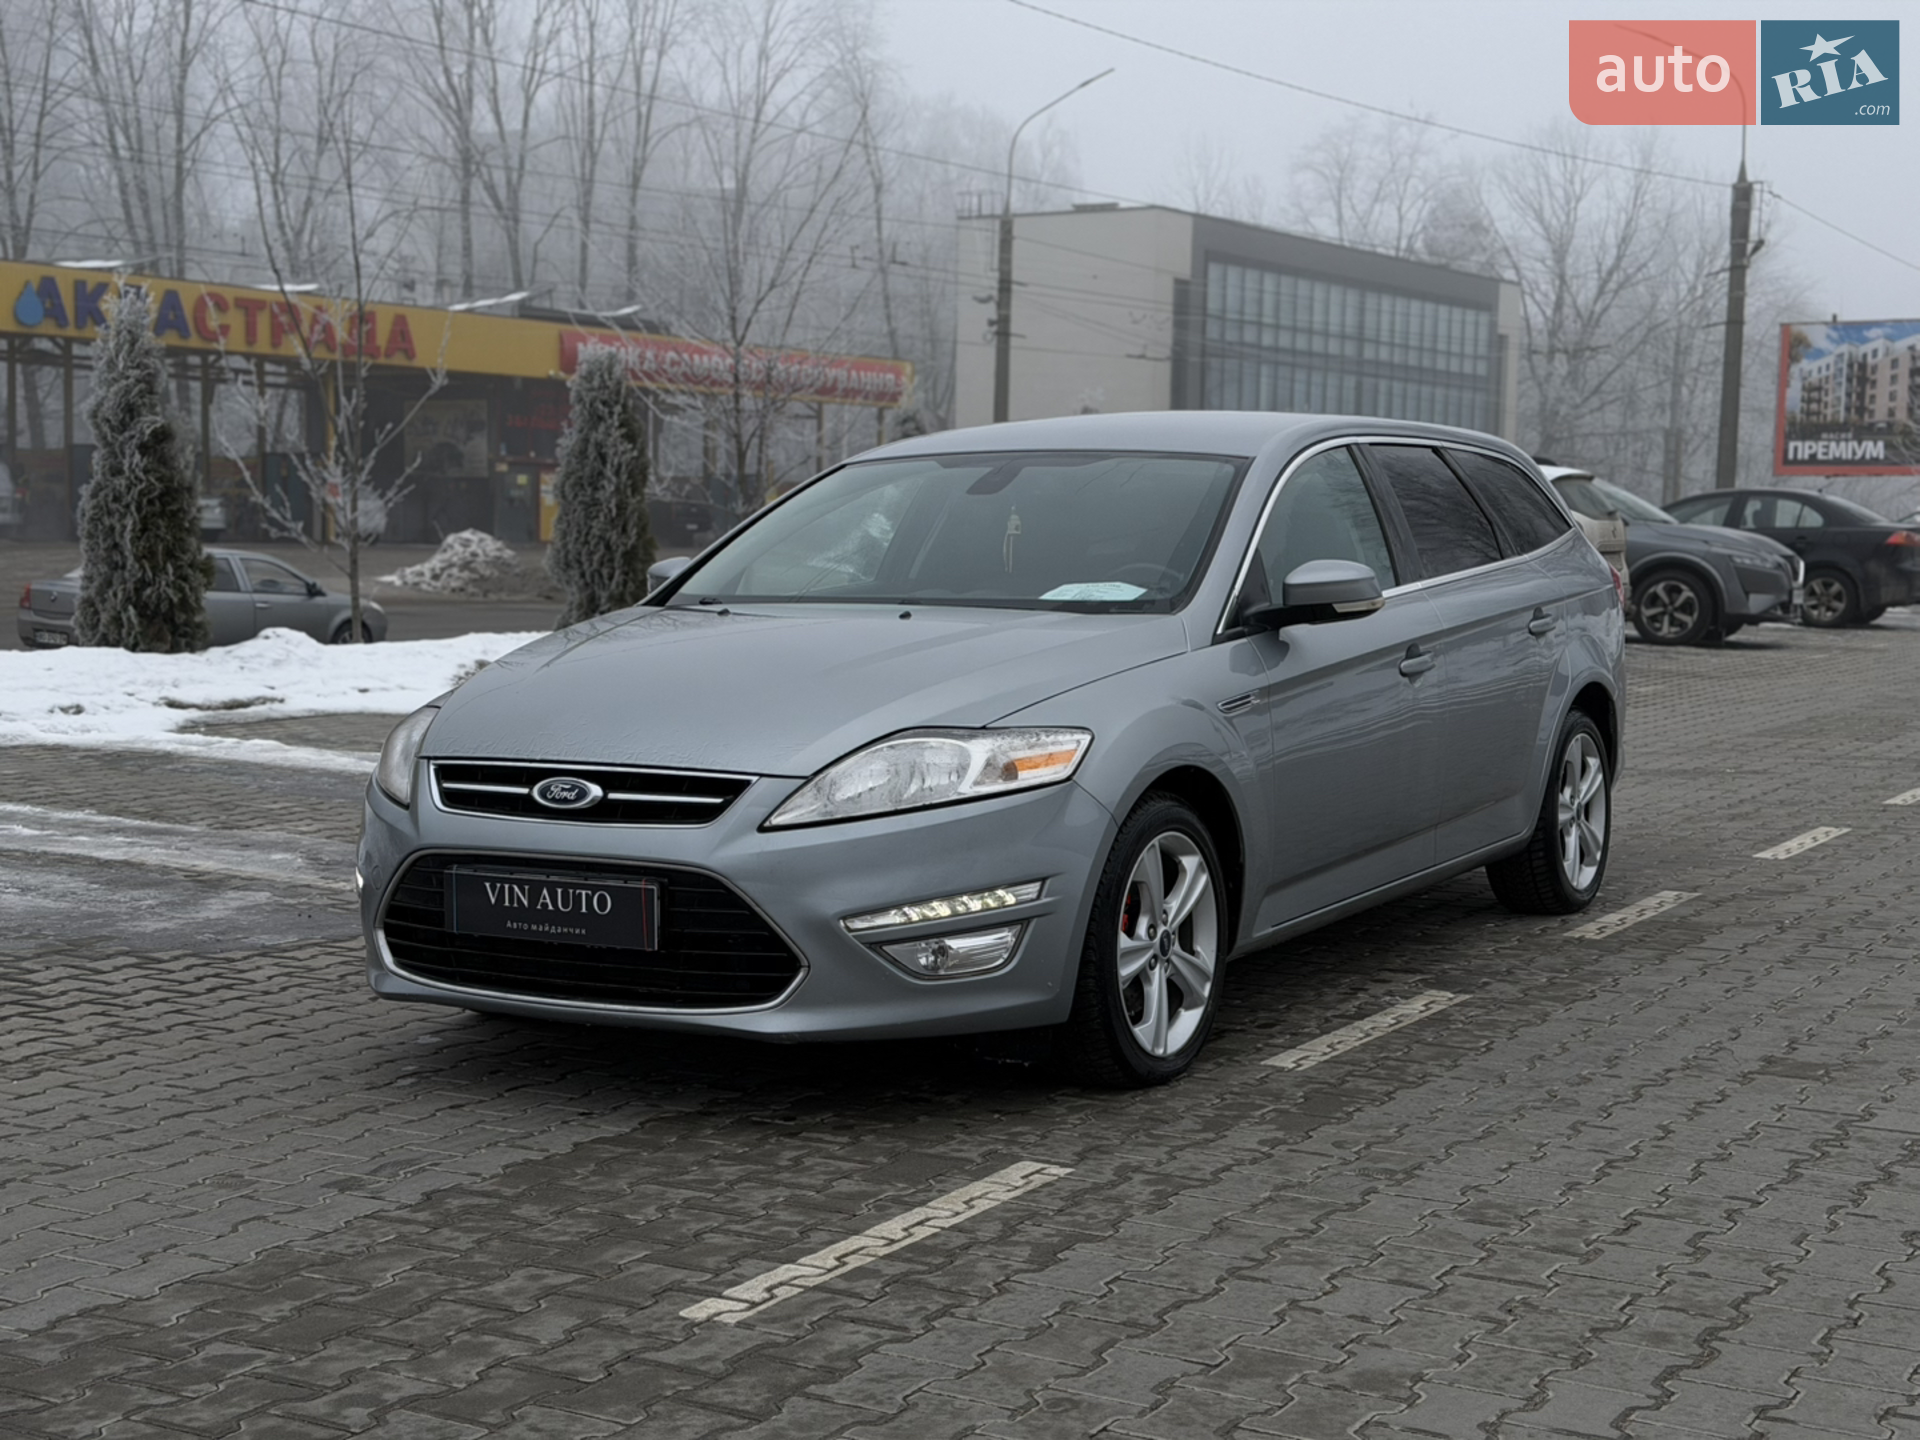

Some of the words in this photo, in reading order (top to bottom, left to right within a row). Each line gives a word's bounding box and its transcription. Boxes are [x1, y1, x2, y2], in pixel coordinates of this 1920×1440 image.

[37, 275, 417, 361] АКАСТРАДА
[1787, 440, 1885, 461] ПРЕМІУМ
[546, 784, 579, 800] Ford
[484, 882, 530, 909] VIN
[536, 886, 612, 915] AUTO
[506, 920, 529, 931] Авто
[531, 922, 587, 936] майданчик
